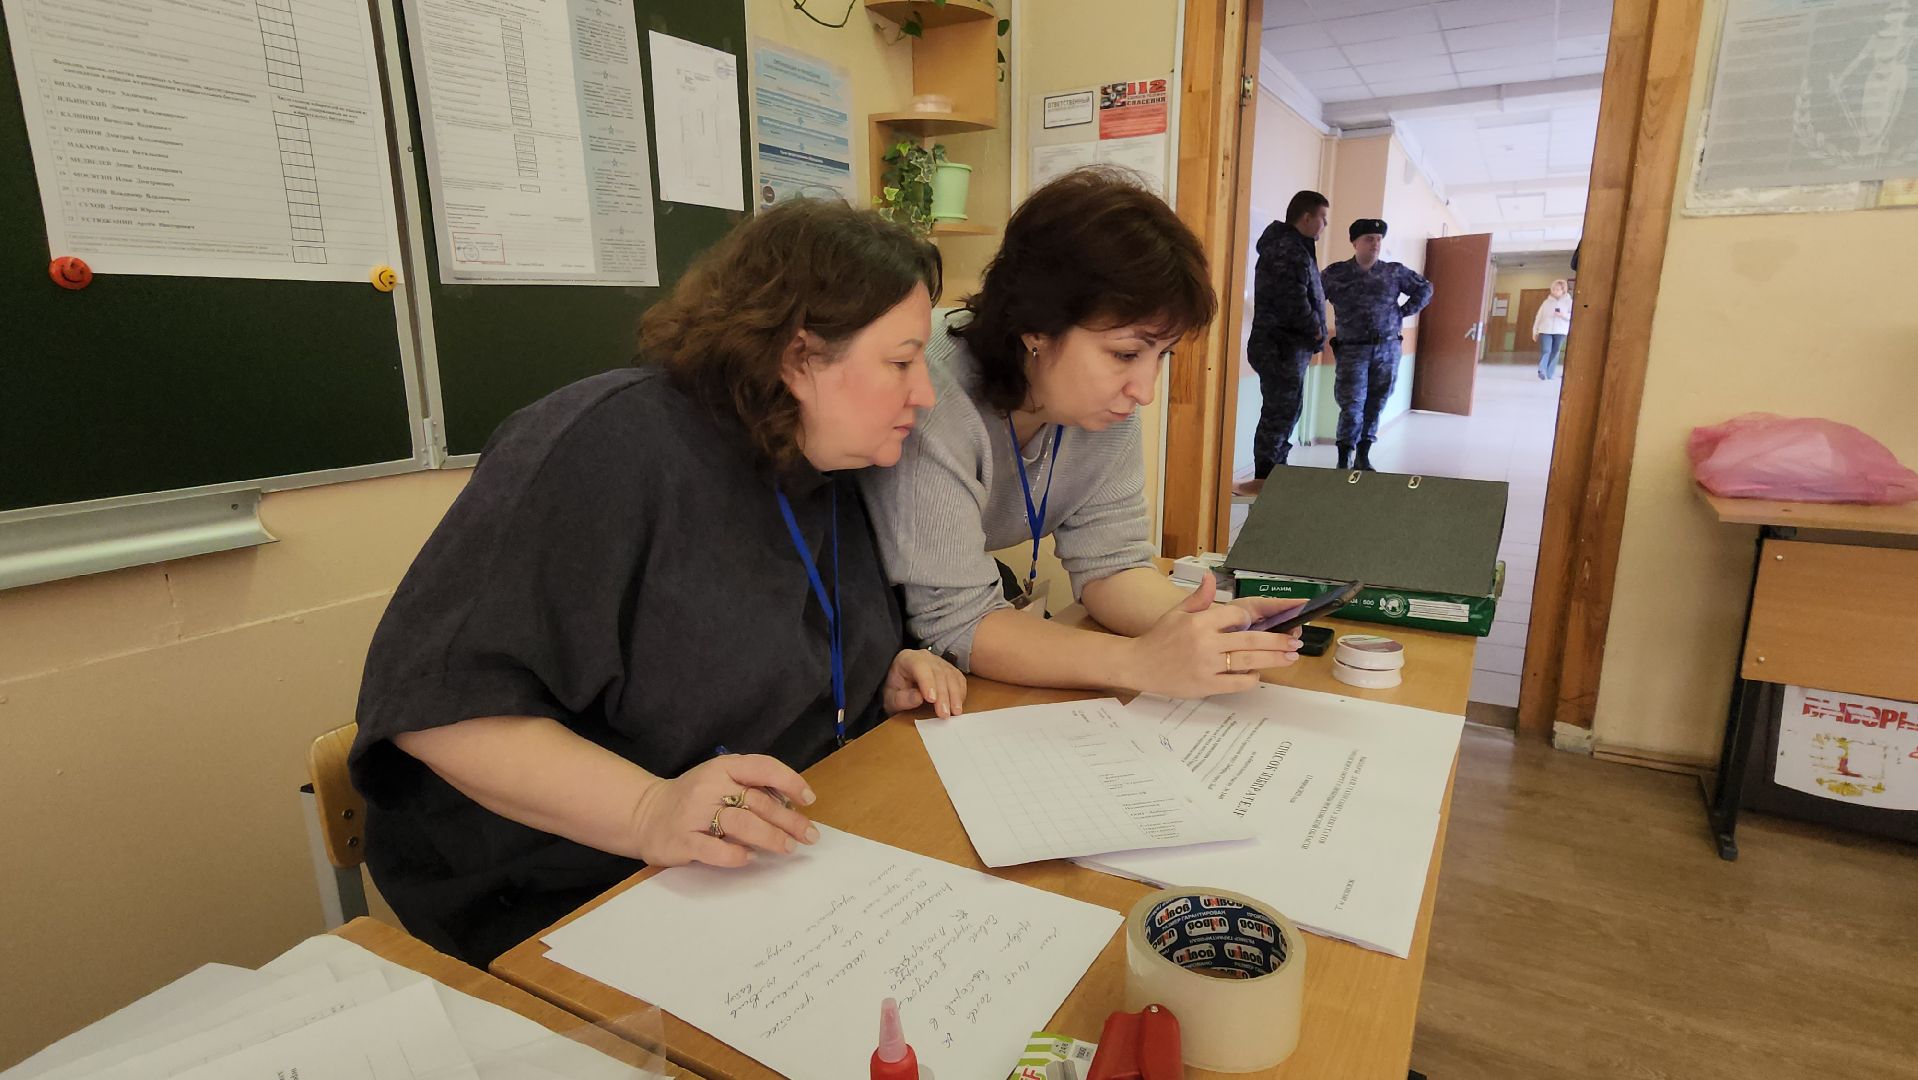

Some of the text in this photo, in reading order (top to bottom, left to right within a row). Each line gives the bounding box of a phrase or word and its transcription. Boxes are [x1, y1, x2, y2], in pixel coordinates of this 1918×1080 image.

[1127, 79, 1167, 96] 112
[1265, 740, 1293, 772] СПИСОК
[1233, 772, 1274, 817] ИЗБИРАТЕЛ
[1157, 902, 1190, 926] UNIBOB
[1188, 917, 1226, 932] UNIBOB
[1240, 919, 1272, 938] UNIBOB
[1152, 930, 1176, 950] UNIBO
[1176, 949, 1215, 964] UNIBOB
[1228, 946, 1262, 964] UNIBOB
